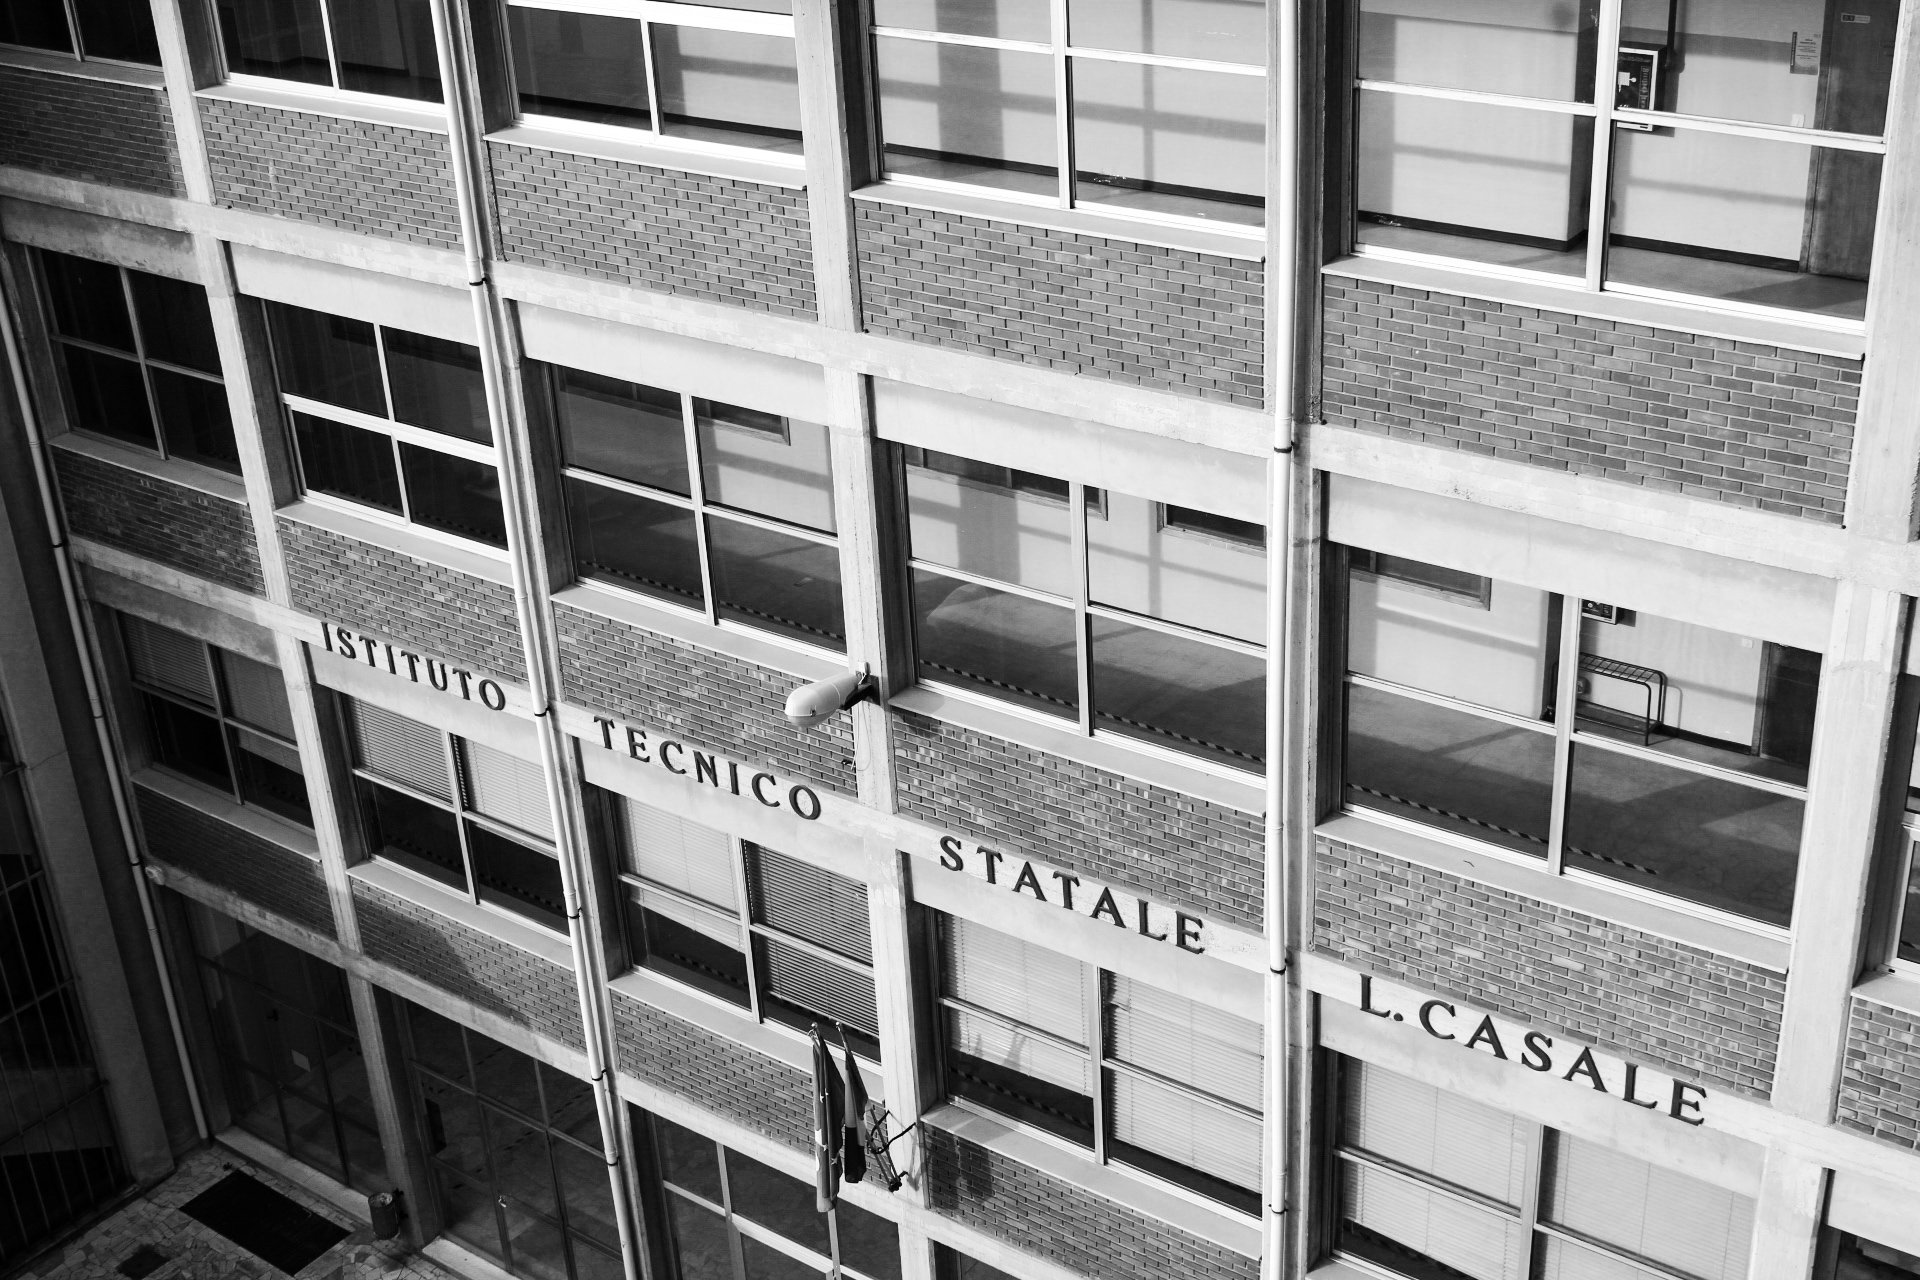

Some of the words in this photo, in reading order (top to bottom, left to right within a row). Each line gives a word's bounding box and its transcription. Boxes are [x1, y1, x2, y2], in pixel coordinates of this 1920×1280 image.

[320, 621, 506, 711] ISTITUTO
[593, 716, 822, 821] TECNICO
[939, 835, 1206, 956] STATALE
